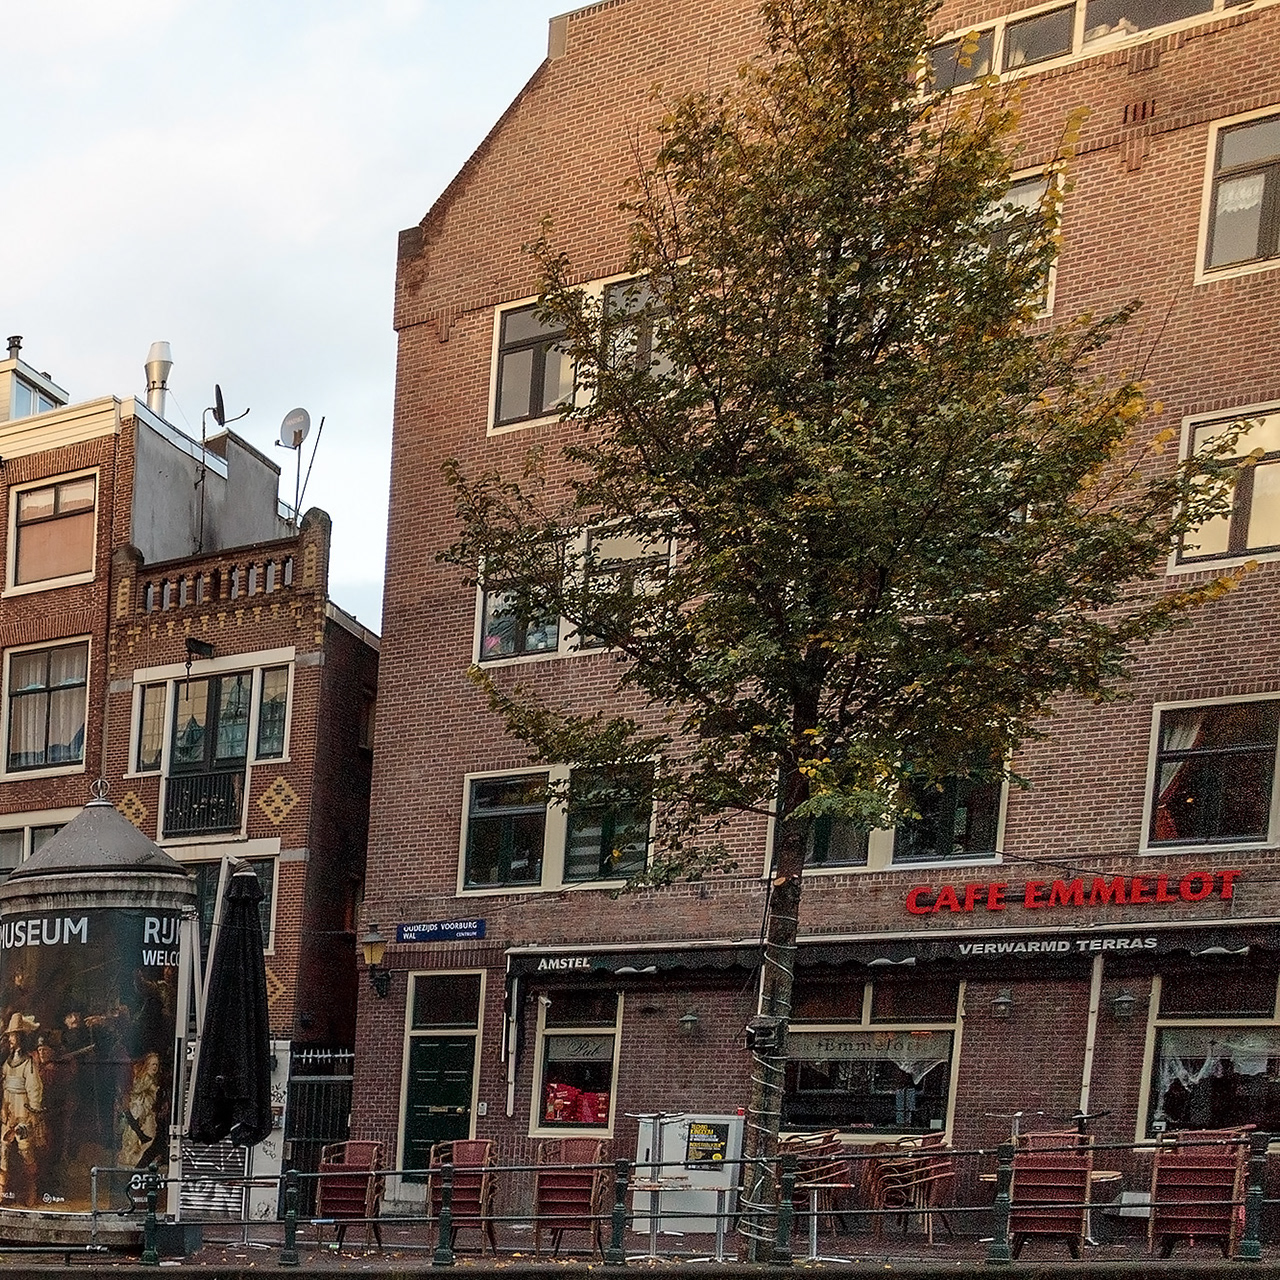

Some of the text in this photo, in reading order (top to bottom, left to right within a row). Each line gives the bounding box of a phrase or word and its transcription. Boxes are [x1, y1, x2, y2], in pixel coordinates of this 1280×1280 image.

[905, 870, 1242, 915] CAFE EMMELOT
[403, 921, 478, 933] OUDEZIJDS VOORBURG
[402, 932, 416, 940] WAL
[958, 937, 1158, 956] VERWARMD TERRAS
[537, 957, 591, 971] AMSTEL
